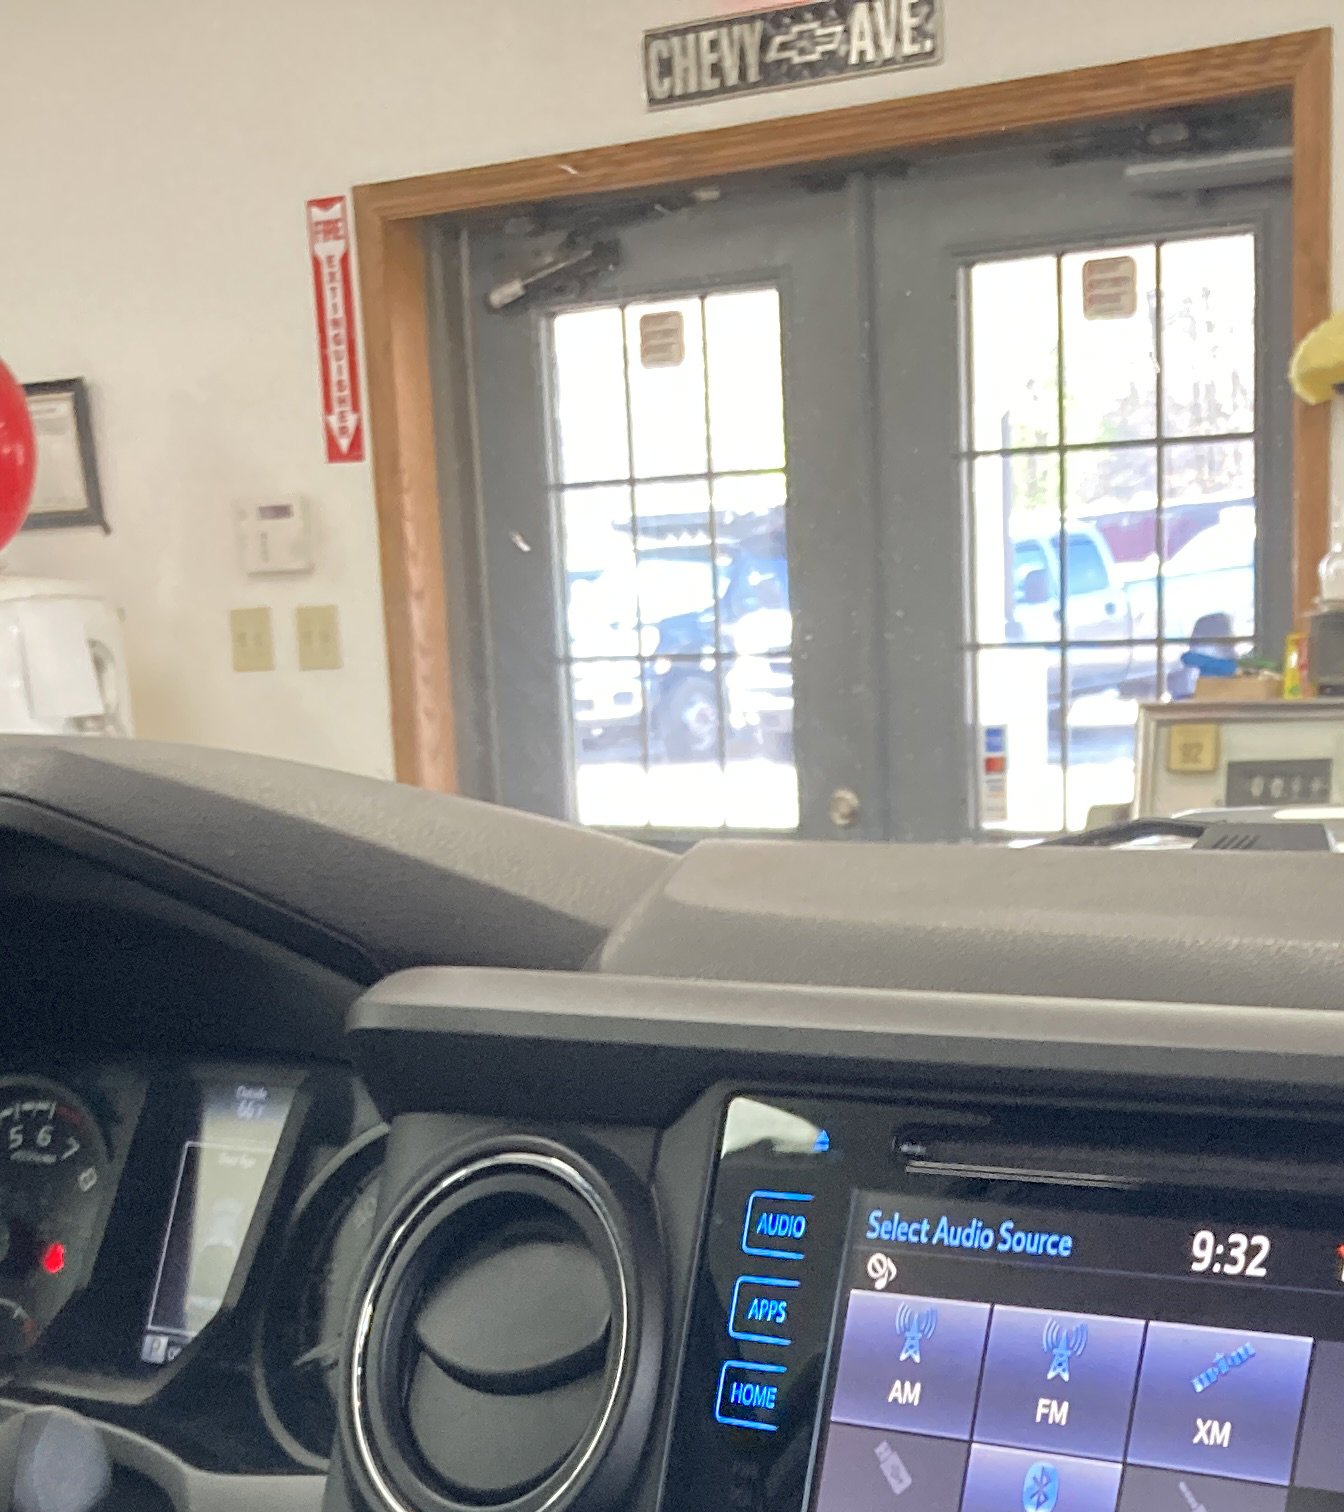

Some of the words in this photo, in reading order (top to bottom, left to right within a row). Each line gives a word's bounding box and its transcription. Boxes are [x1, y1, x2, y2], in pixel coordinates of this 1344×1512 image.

[648, 18, 764, 99] CHEVY
[9, 1125, 23, 1149] 5
[36, 1125, 53, 1147] 6
[756, 1211, 806, 1239] AUDIO
[865, 1208, 930, 1244] Select
[931, 1214, 994, 1249] Audio
[996, 1219, 1073, 1258] Source
[1190, 1229, 1272, 1278] 9:32
[747, 1297, 787, 1324] APPS
[730, 1382, 778, 1409] HOME
[887, 1379, 922, 1406] AM
[1035, 1398, 1069, 1426] FM
[1192, 1418, 1232, 1448] XM
